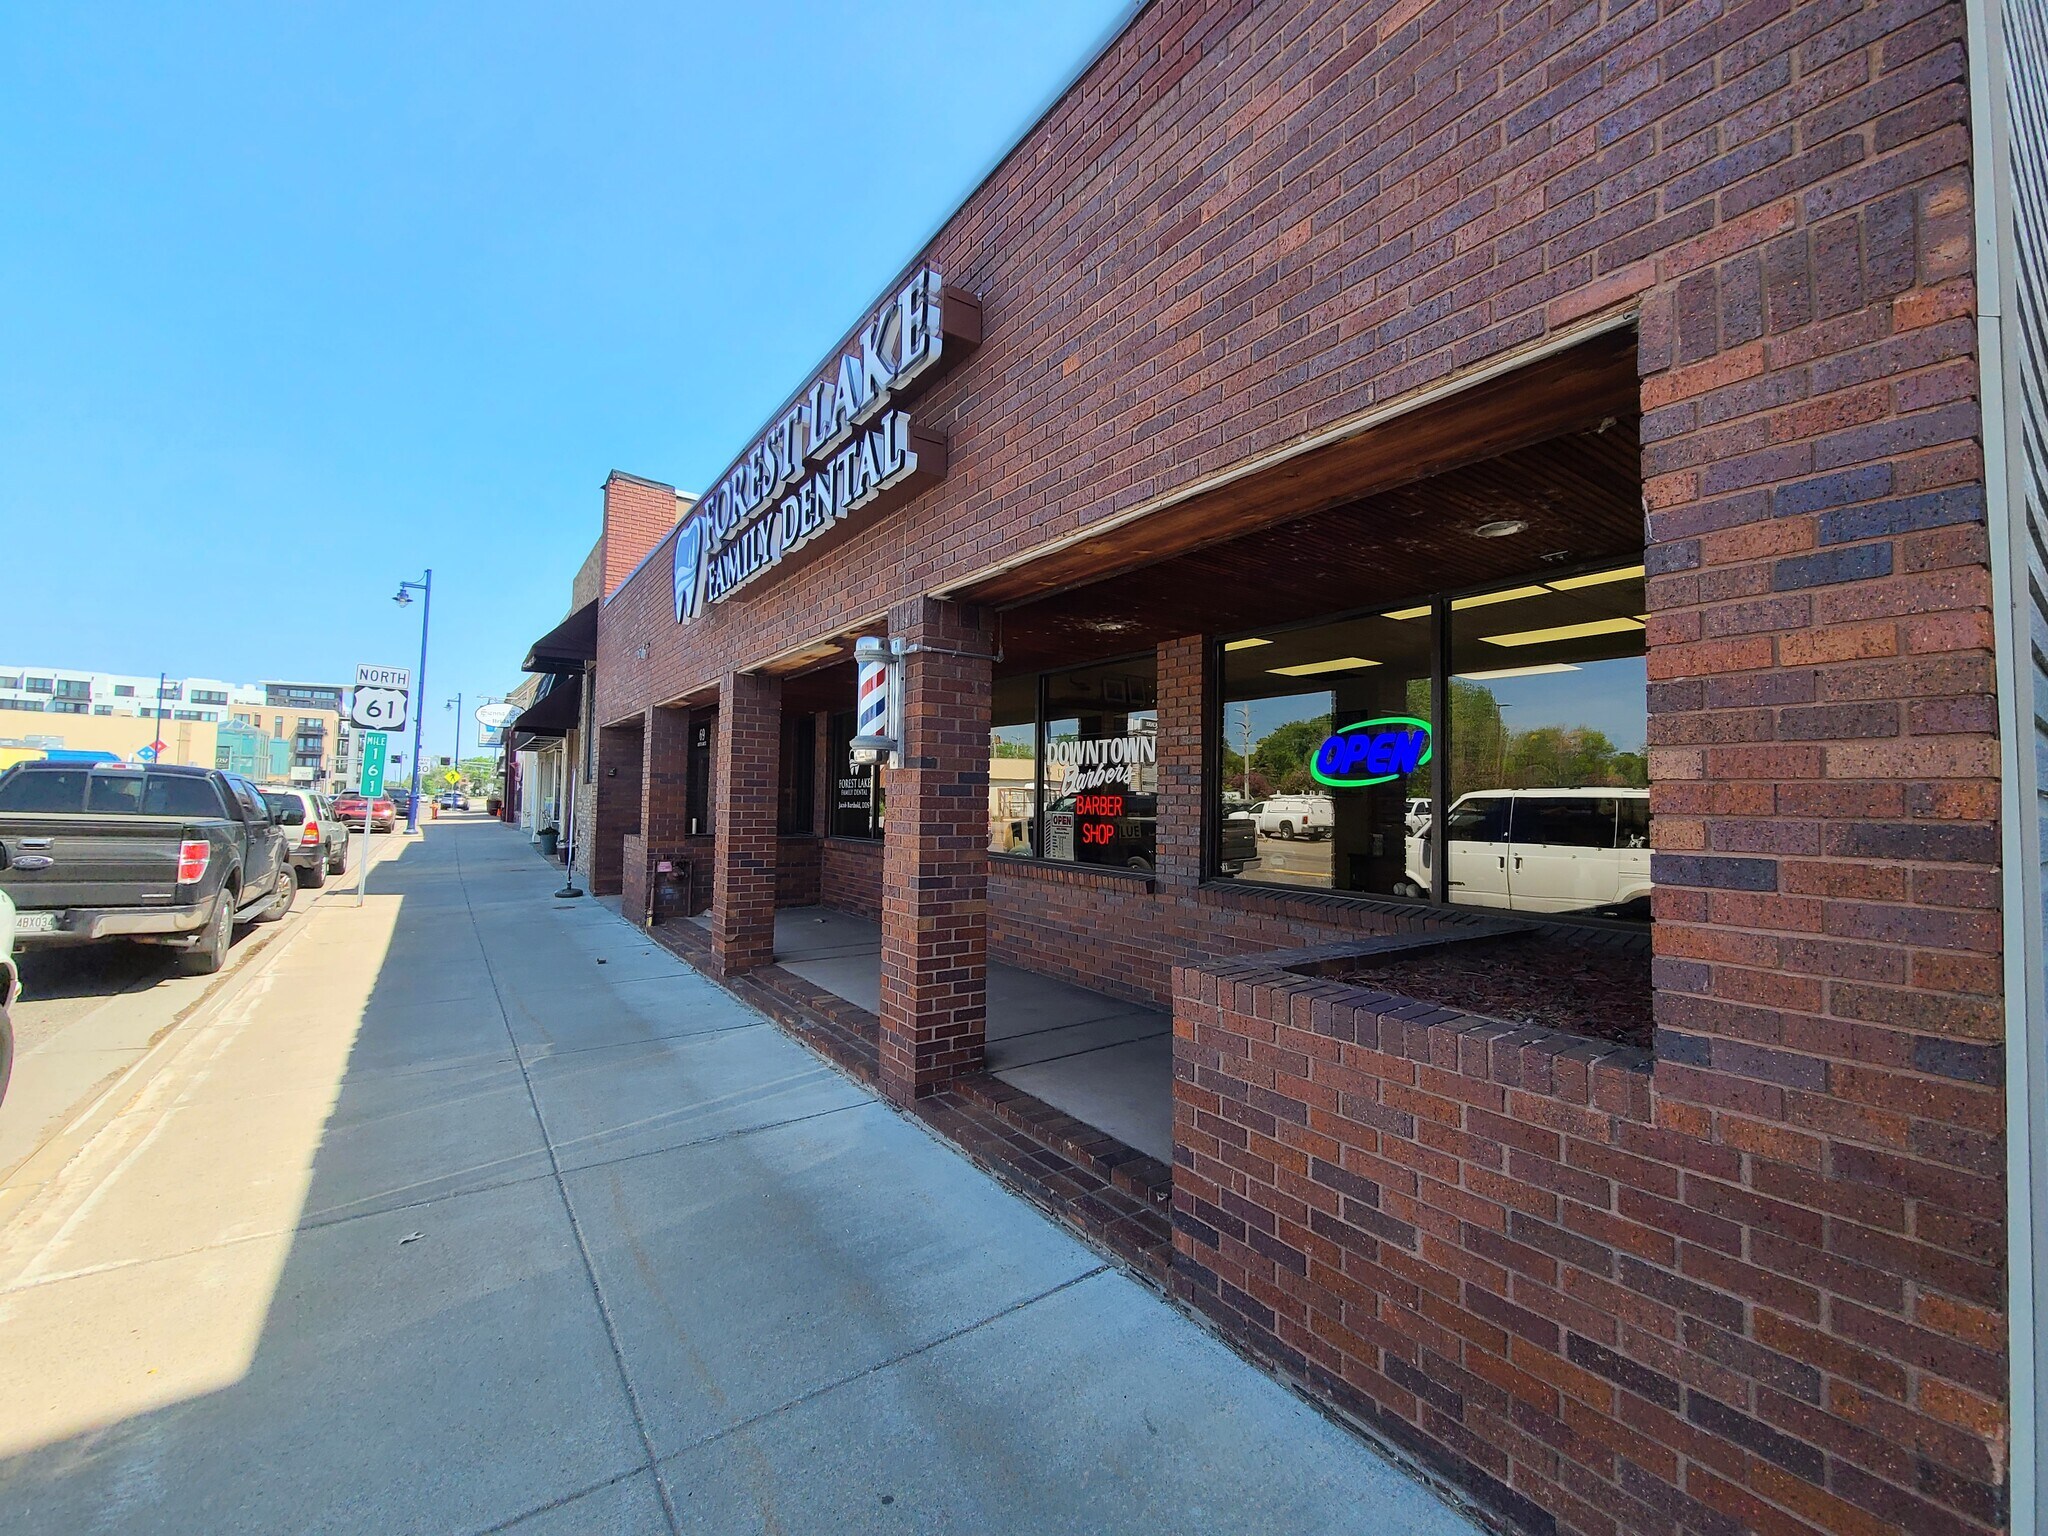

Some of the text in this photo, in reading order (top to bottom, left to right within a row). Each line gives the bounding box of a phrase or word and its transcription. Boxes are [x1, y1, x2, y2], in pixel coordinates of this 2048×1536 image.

[704, 266, 944, 553] FOREST LAKE
[707, 408, 918, 604] FAMILY DENTAL
[359, 668, 407, 685] NORTH
[366, 699, 394, 719] 61
[367, 736, 386, 746] MILE
[1047, 736, 1156, 766] DOWNTOWN
[1317, 730, 1424, 774] OPEN
[838, 778, 871, 788] FOREST LAKE
[1061, 762, 1133, 797] Barbers
[1075, 795, 1123, 816] BARBER
[1053, 815, 1072, 826] OPEN
[1082, 823, 1114, 845] SHOP
